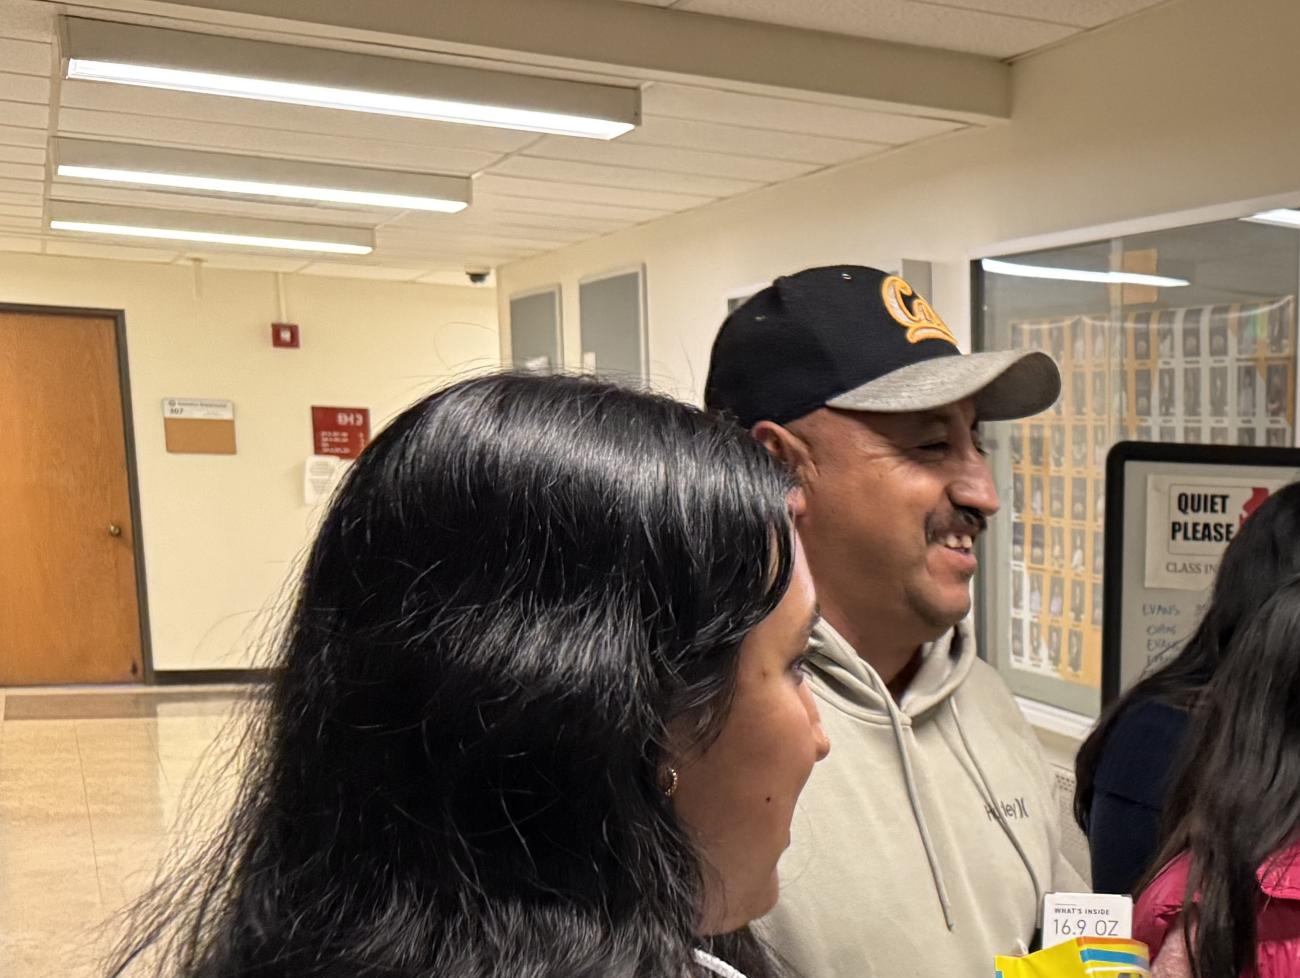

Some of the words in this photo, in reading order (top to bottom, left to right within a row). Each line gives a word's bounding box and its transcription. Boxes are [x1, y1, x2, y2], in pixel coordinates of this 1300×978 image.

[1177, 492, 1230, 515] QUIET
[1170, 521, 1234, 542] PLEASE
[1165, 561, 1202, 575] CLASS
[1054, 907, 1083, 915] WHAT'S
[1085, 908, 1110, 916] INSIDE
[1053, 919, 1087, 936] 16.9
[1095, 920, 1119, 937] OZ
